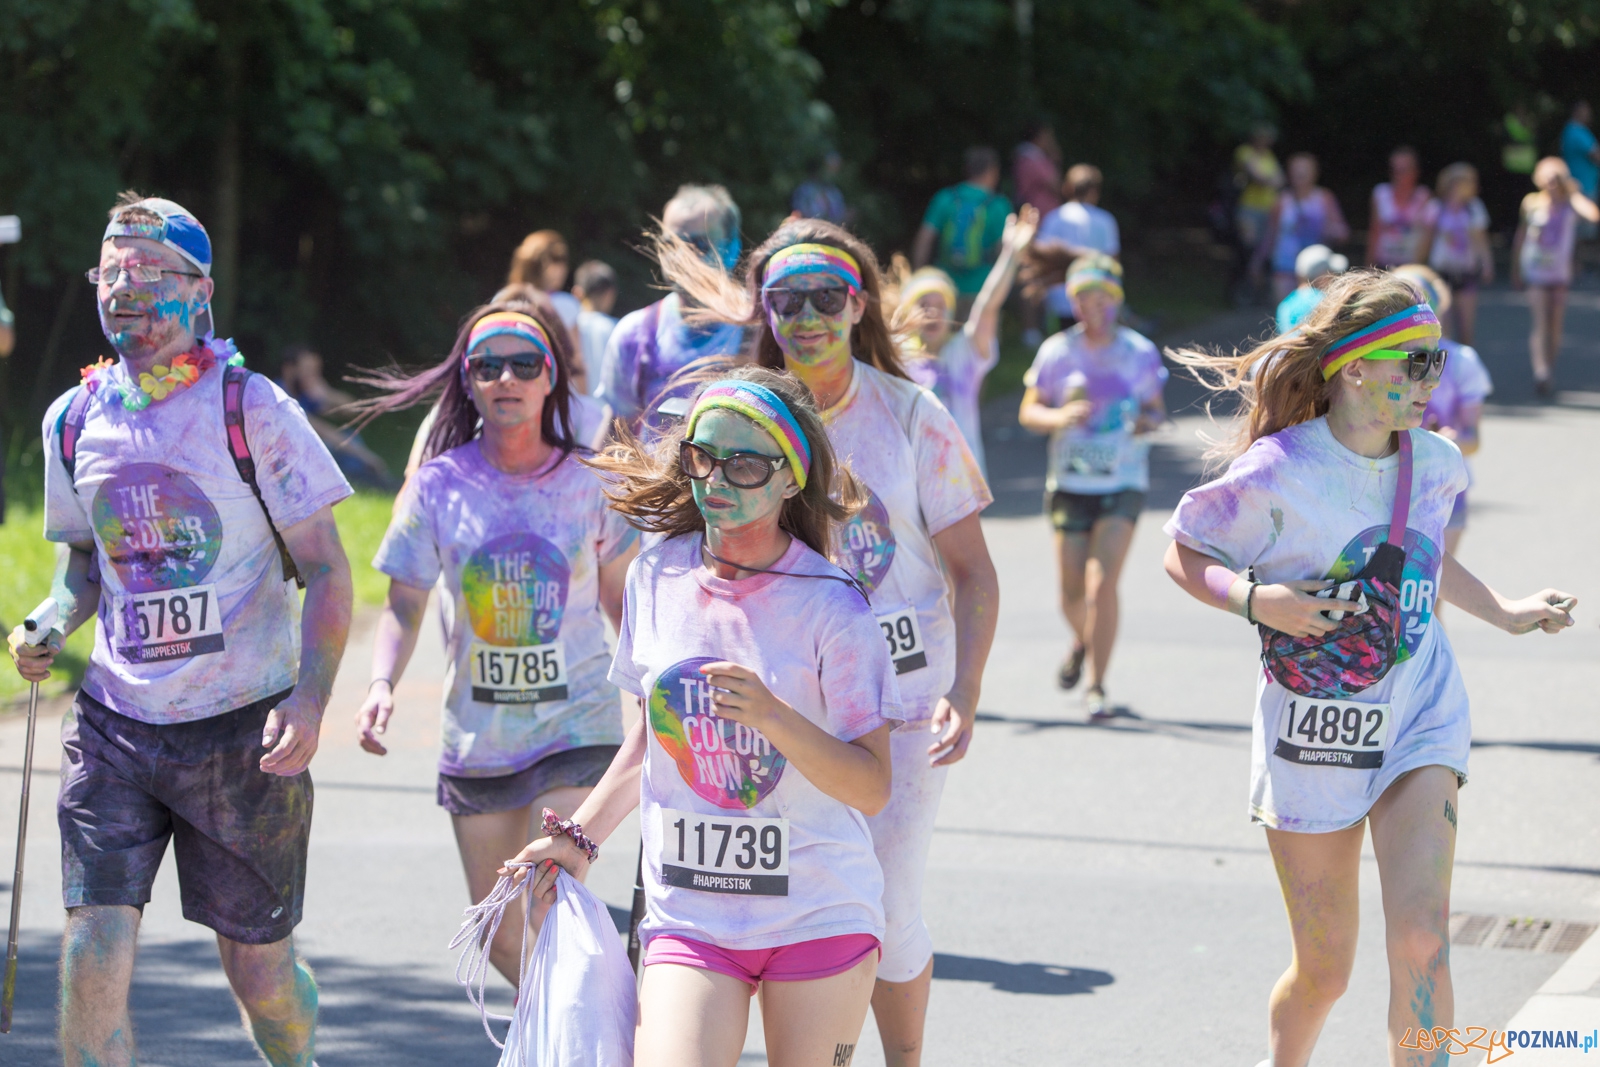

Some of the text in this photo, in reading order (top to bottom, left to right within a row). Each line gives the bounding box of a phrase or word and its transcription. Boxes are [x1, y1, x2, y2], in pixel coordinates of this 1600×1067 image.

[1387, 391, 1401, 401] RUN
[116, 484, 163, 519] THE
[122, 515, 208, 549] COLOR
[489, 551, 532, 581] THE
[492, 580, 561, 611] COLOR
[495, 609, 534, 640] RUN
[141, 641, 192, 659] #HAPPIEST5K
[477, 649, 560, 686] 15785
[679, 678, 717, 718] TH
[682, 716, 771, 757] COLOR
[1287, 701, 1384, 748] 14892
[693, 751, 743, 791] RUN
[1298, 749, 1354, 764] #HAPPIEST5K
[673, 818, 782, 871] 11739
[693, 873, 752, 891] #HAPPIEST5K
